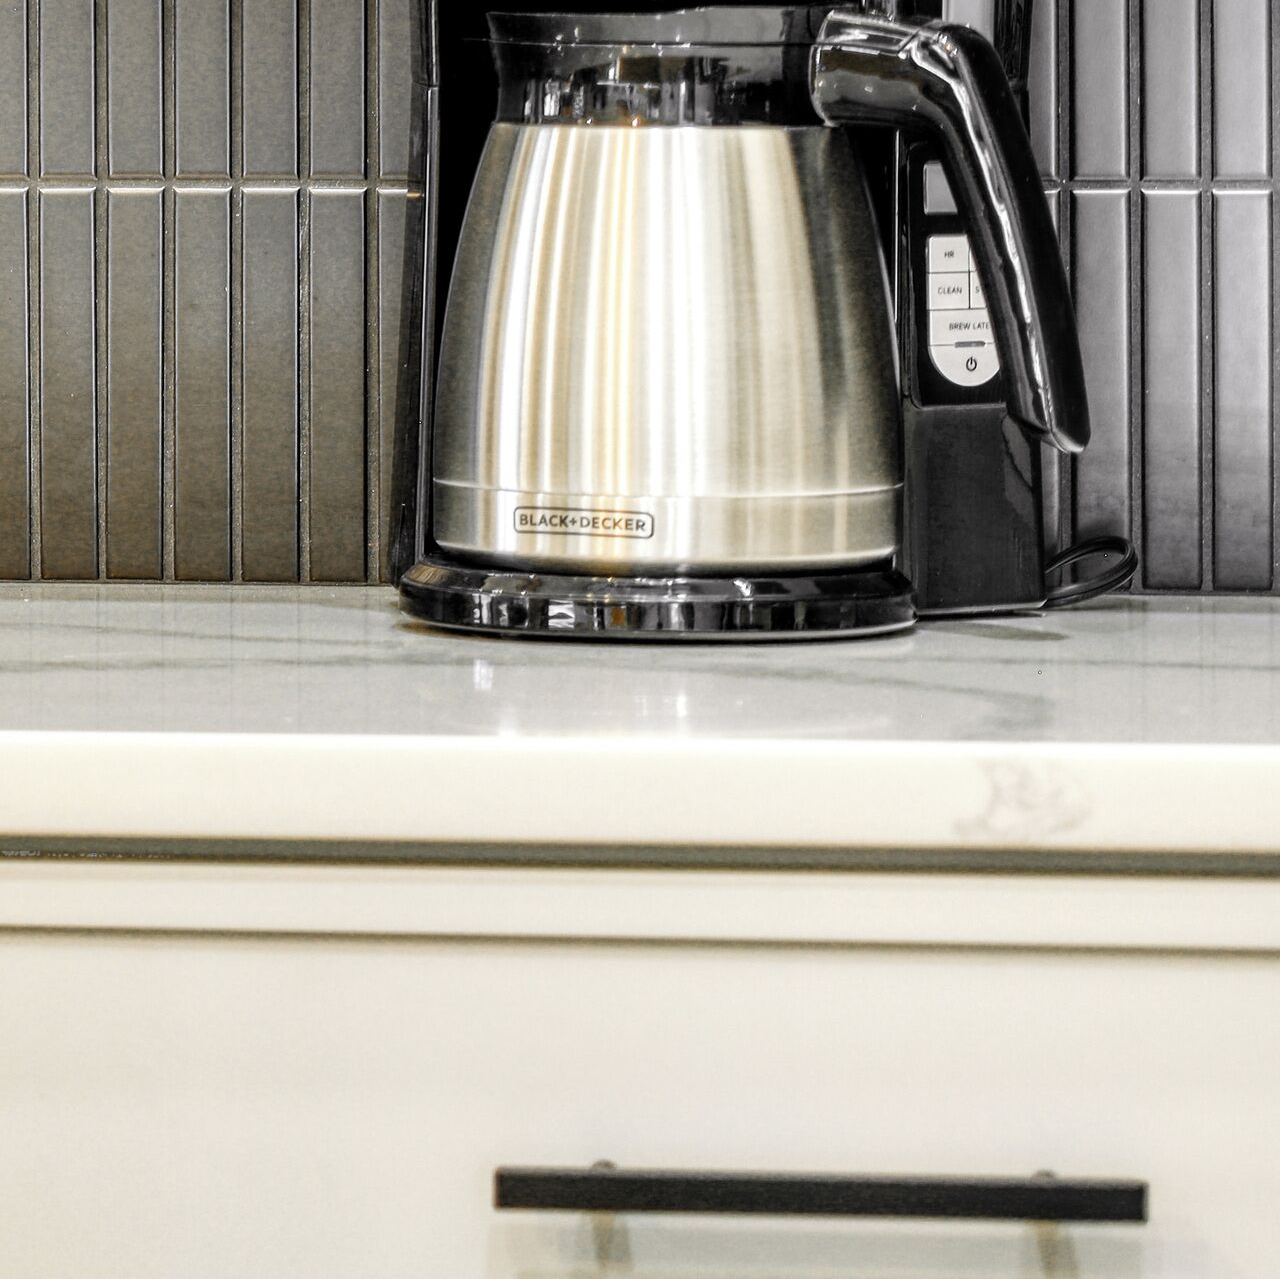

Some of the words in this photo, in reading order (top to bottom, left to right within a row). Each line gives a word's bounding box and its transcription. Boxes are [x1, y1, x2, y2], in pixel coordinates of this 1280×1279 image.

[944, 250, 955, 258] HR
[937, 286, 963, 295] CLEAN
[949, 323, 971, 331] BREW
[972, 322, 990, 330] LATE
[518, 513, 647, 532] BLACK+DECKER
